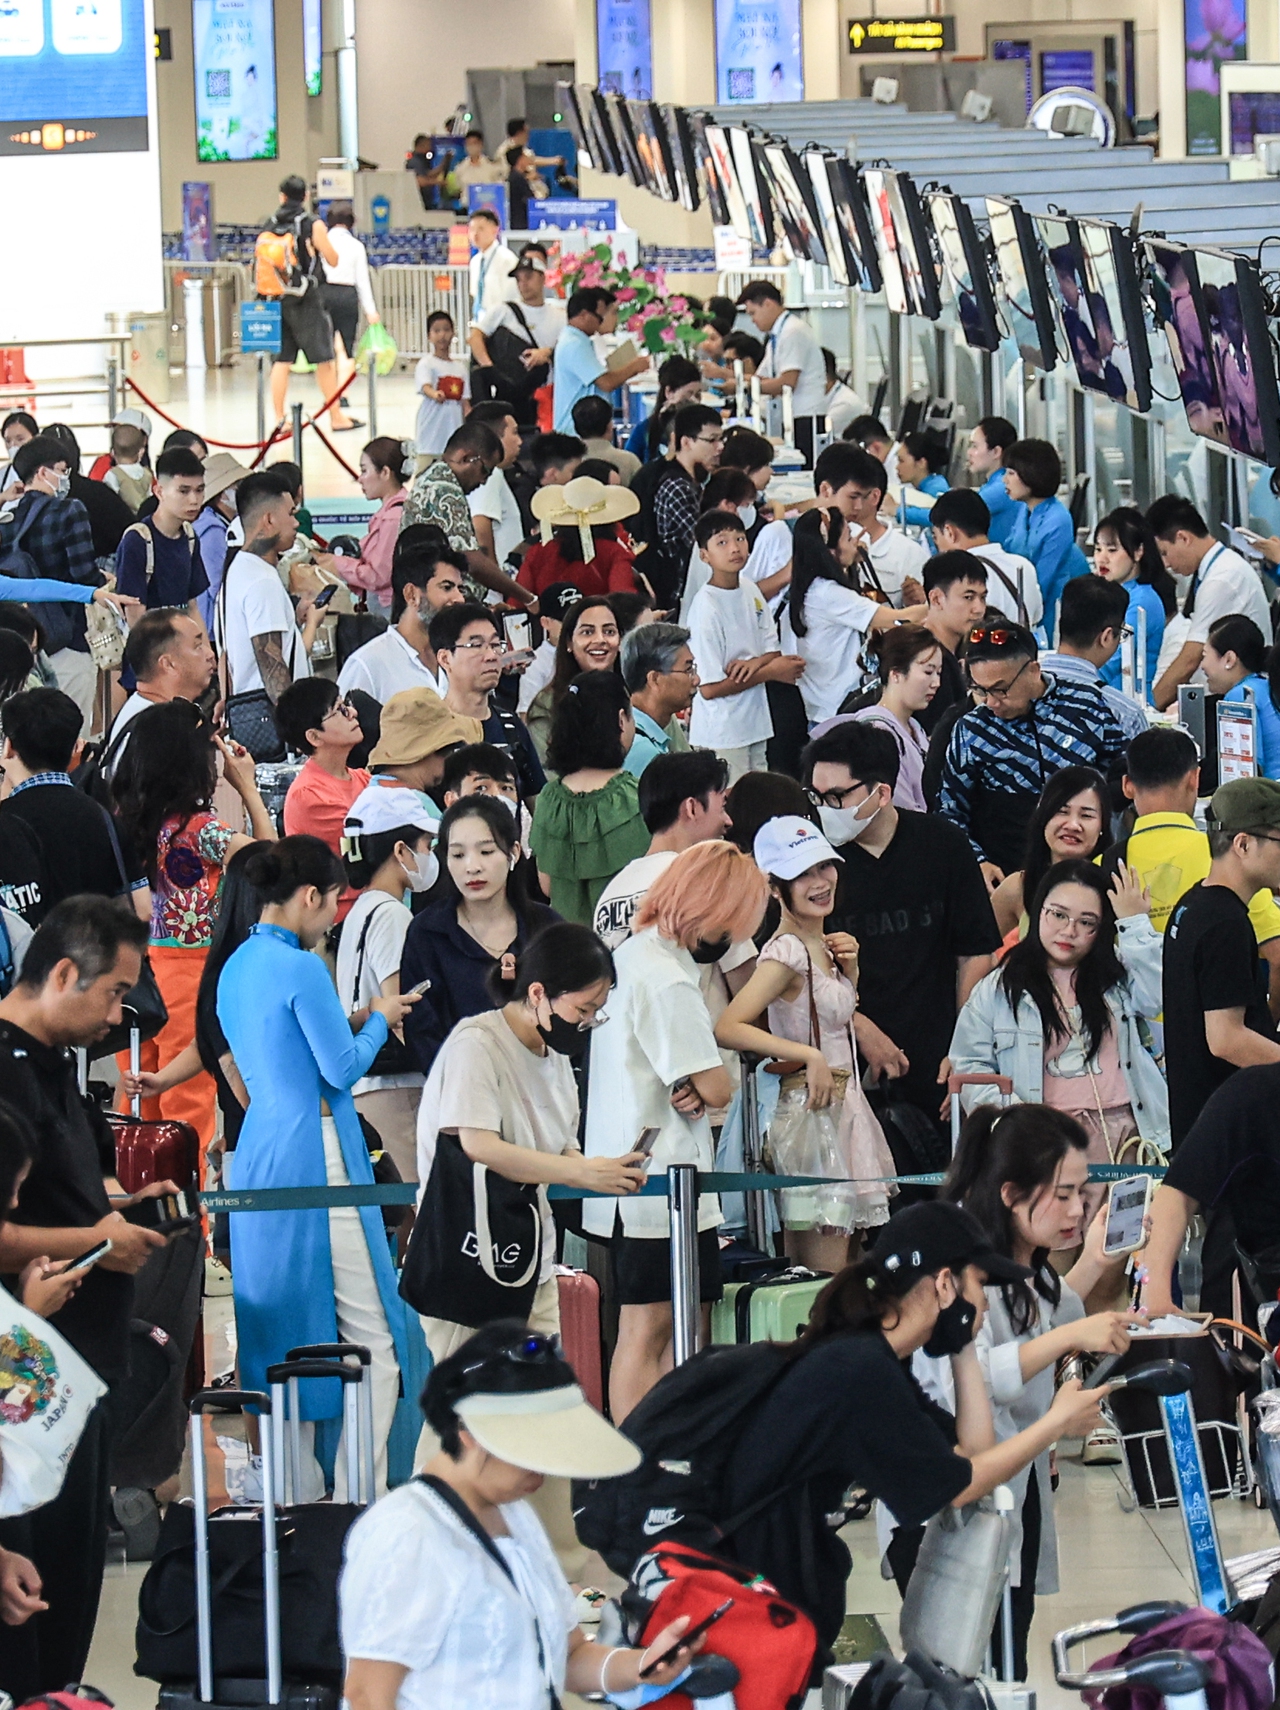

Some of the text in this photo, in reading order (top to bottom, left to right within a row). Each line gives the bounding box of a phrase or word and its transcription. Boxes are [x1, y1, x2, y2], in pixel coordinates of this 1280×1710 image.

[201, 1195, 239, 1207] Airlines
[40, 1396, 70, 1432] JAPAN
[648, 1508, 677, 1524] NIKE
